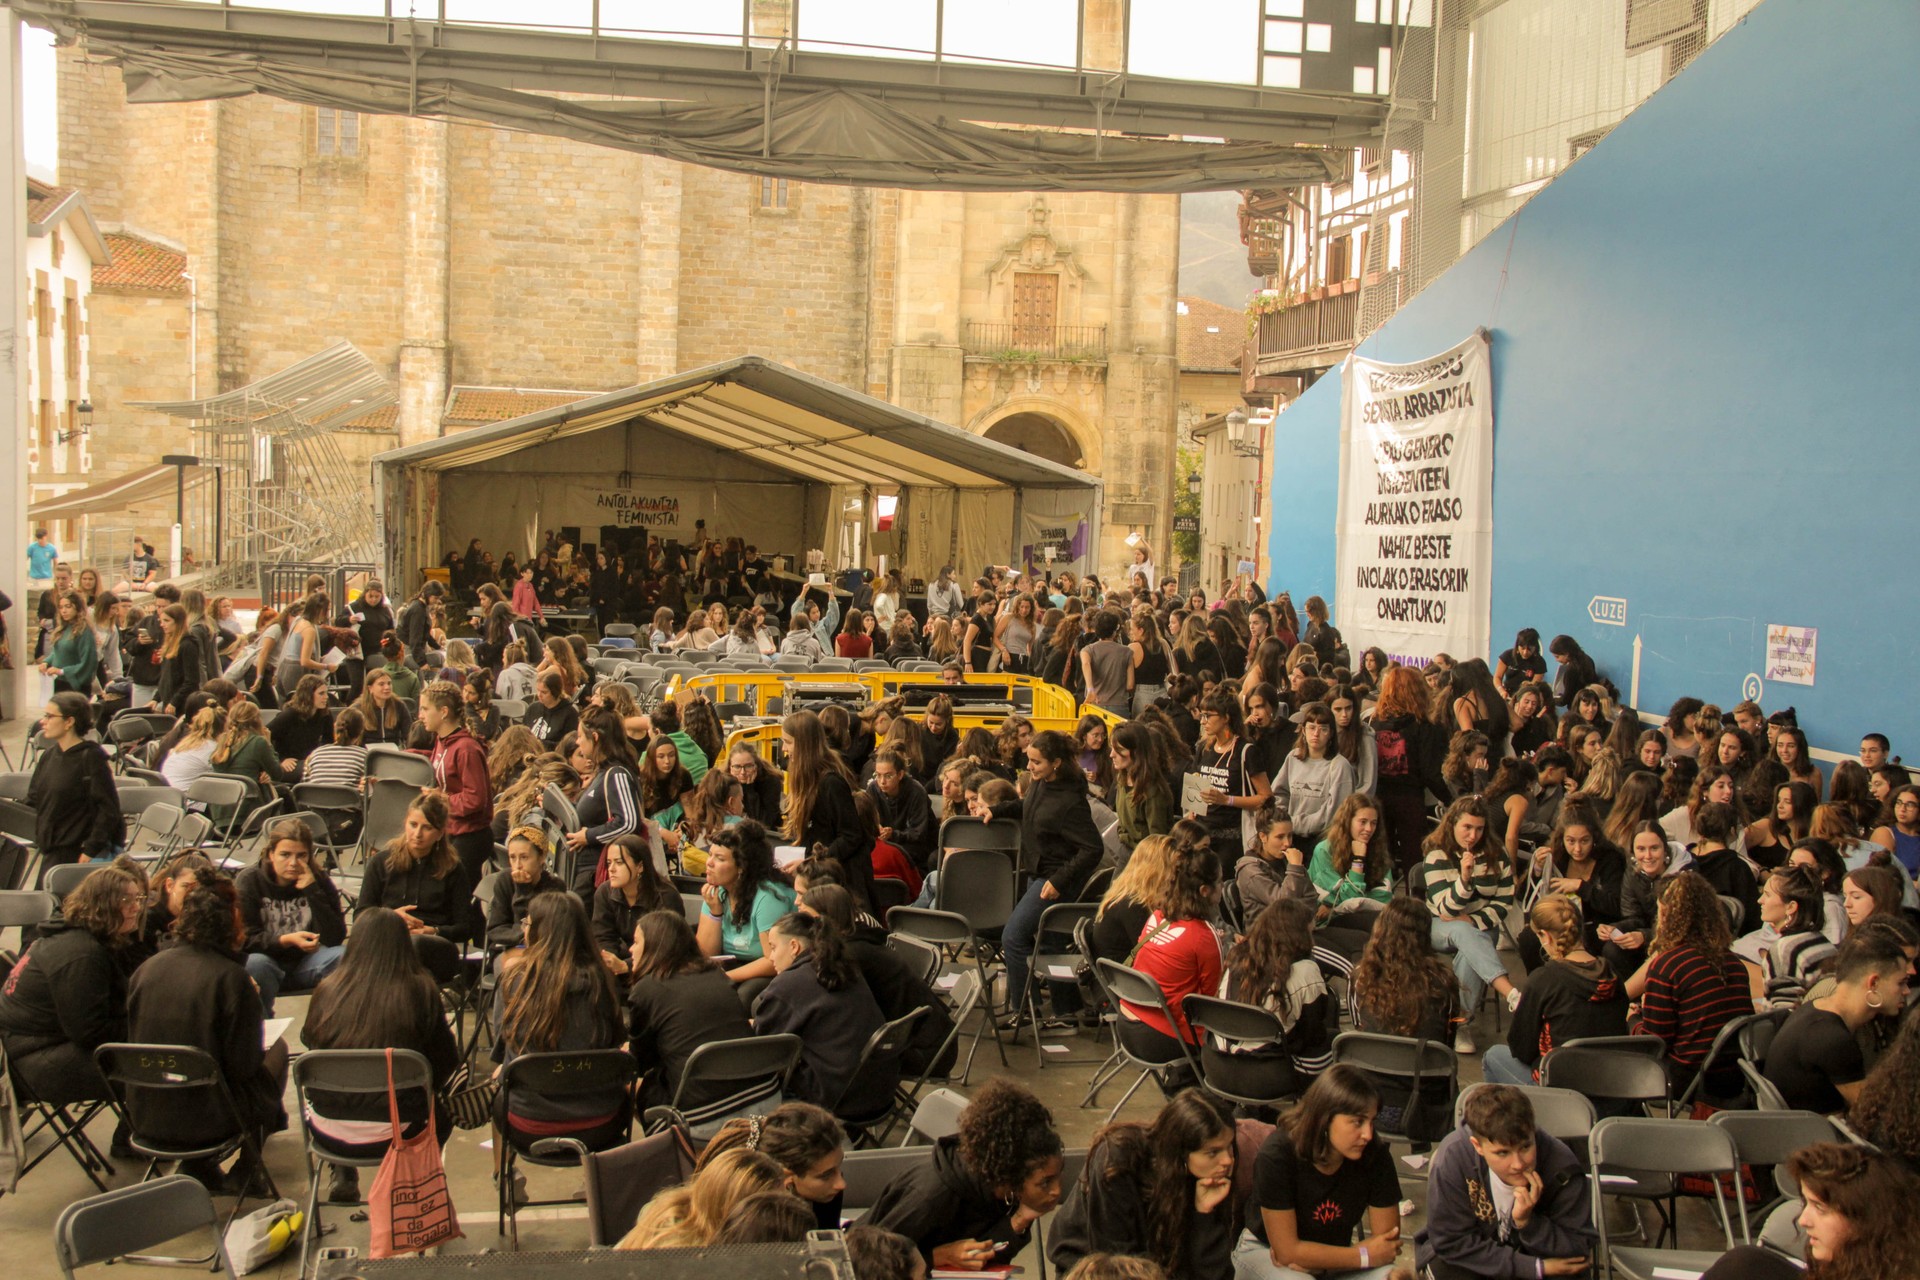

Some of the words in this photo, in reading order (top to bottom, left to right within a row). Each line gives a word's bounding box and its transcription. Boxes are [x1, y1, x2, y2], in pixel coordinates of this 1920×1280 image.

[1402, 433, 1454, 461] GENERO
[596, 493, 680, 511] ANTOLAKUNTZA
[1364, 501, 1420, 526] AURKAKO
[1421, 497, 1462, 524] ERASO
[616, 509, 679, 527] FEMINISTA!
[1378, 535, 1413, 560] NAHIZ
[1413, 534, 1452, 560] BESTE
[1356, 566, 1409, 590] INOLAKO
[1409, 566, 1469, 592] ERASORIK
[1376, 596, 1446, 625] ONARTUKO!
[1594, 601, 1624, 620] LUZE
[1748, 681, 1757, 698] 6
[395, 1190, 420, 1203] inor
[420, 1199, 435, 1213] ez
[407, 1218, 424, 1231] da
[406, 1223, 448, 1246] ilegala
